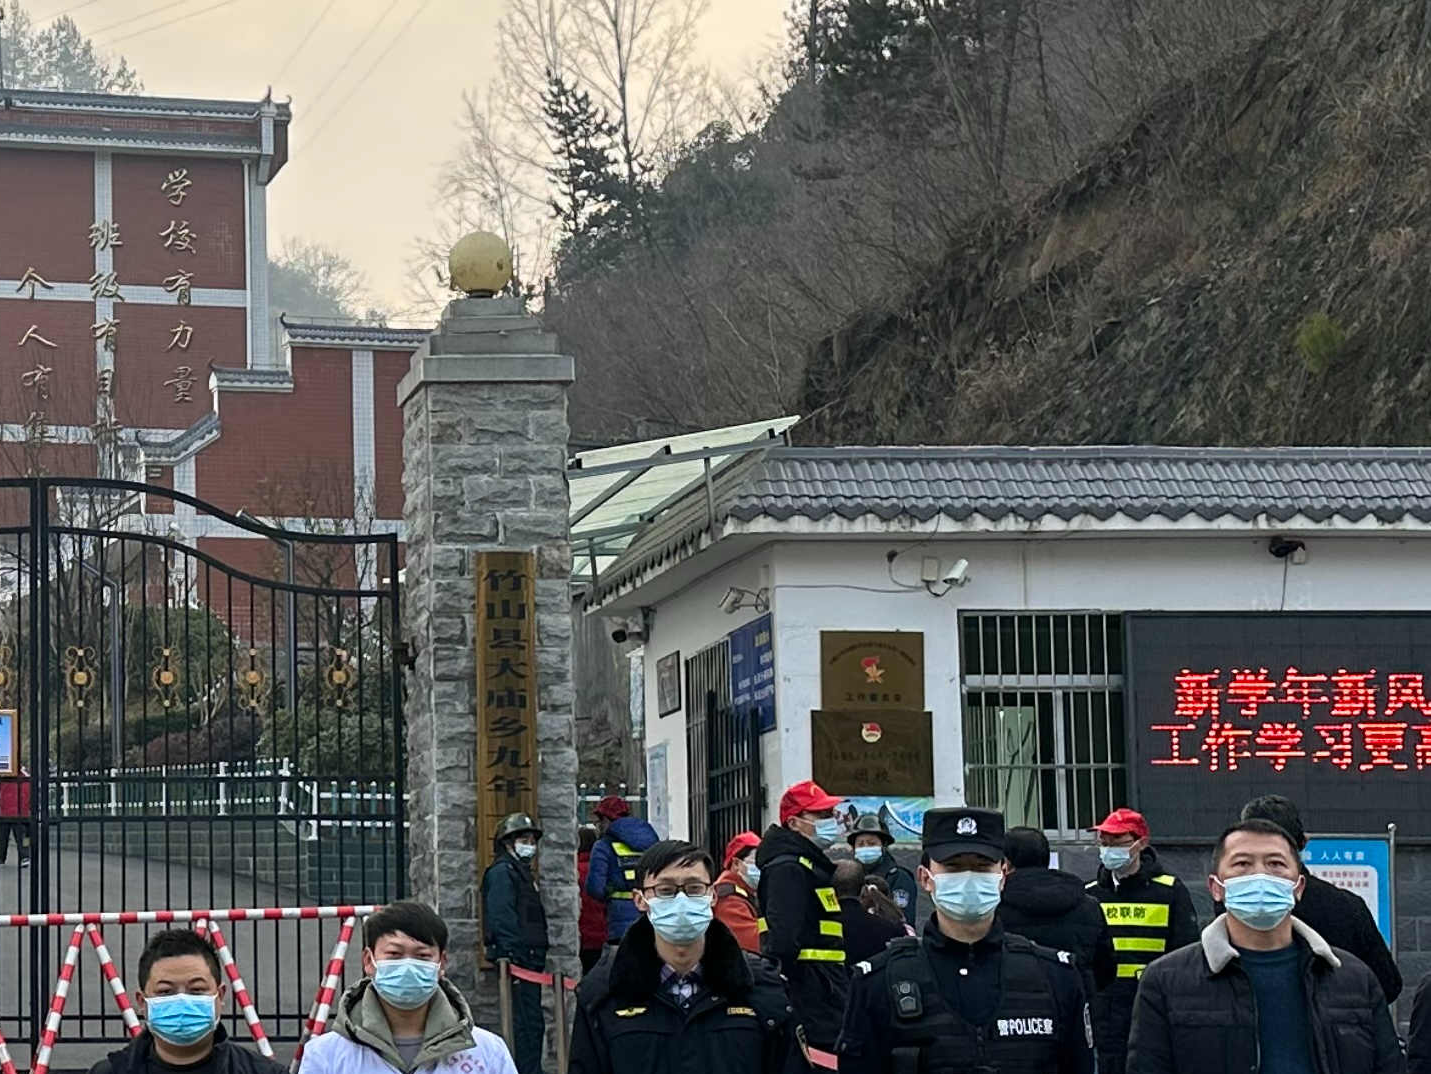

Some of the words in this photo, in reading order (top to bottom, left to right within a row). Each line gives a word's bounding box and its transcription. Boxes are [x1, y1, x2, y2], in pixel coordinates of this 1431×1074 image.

[159, 168, 198, 403] 学校有力量
